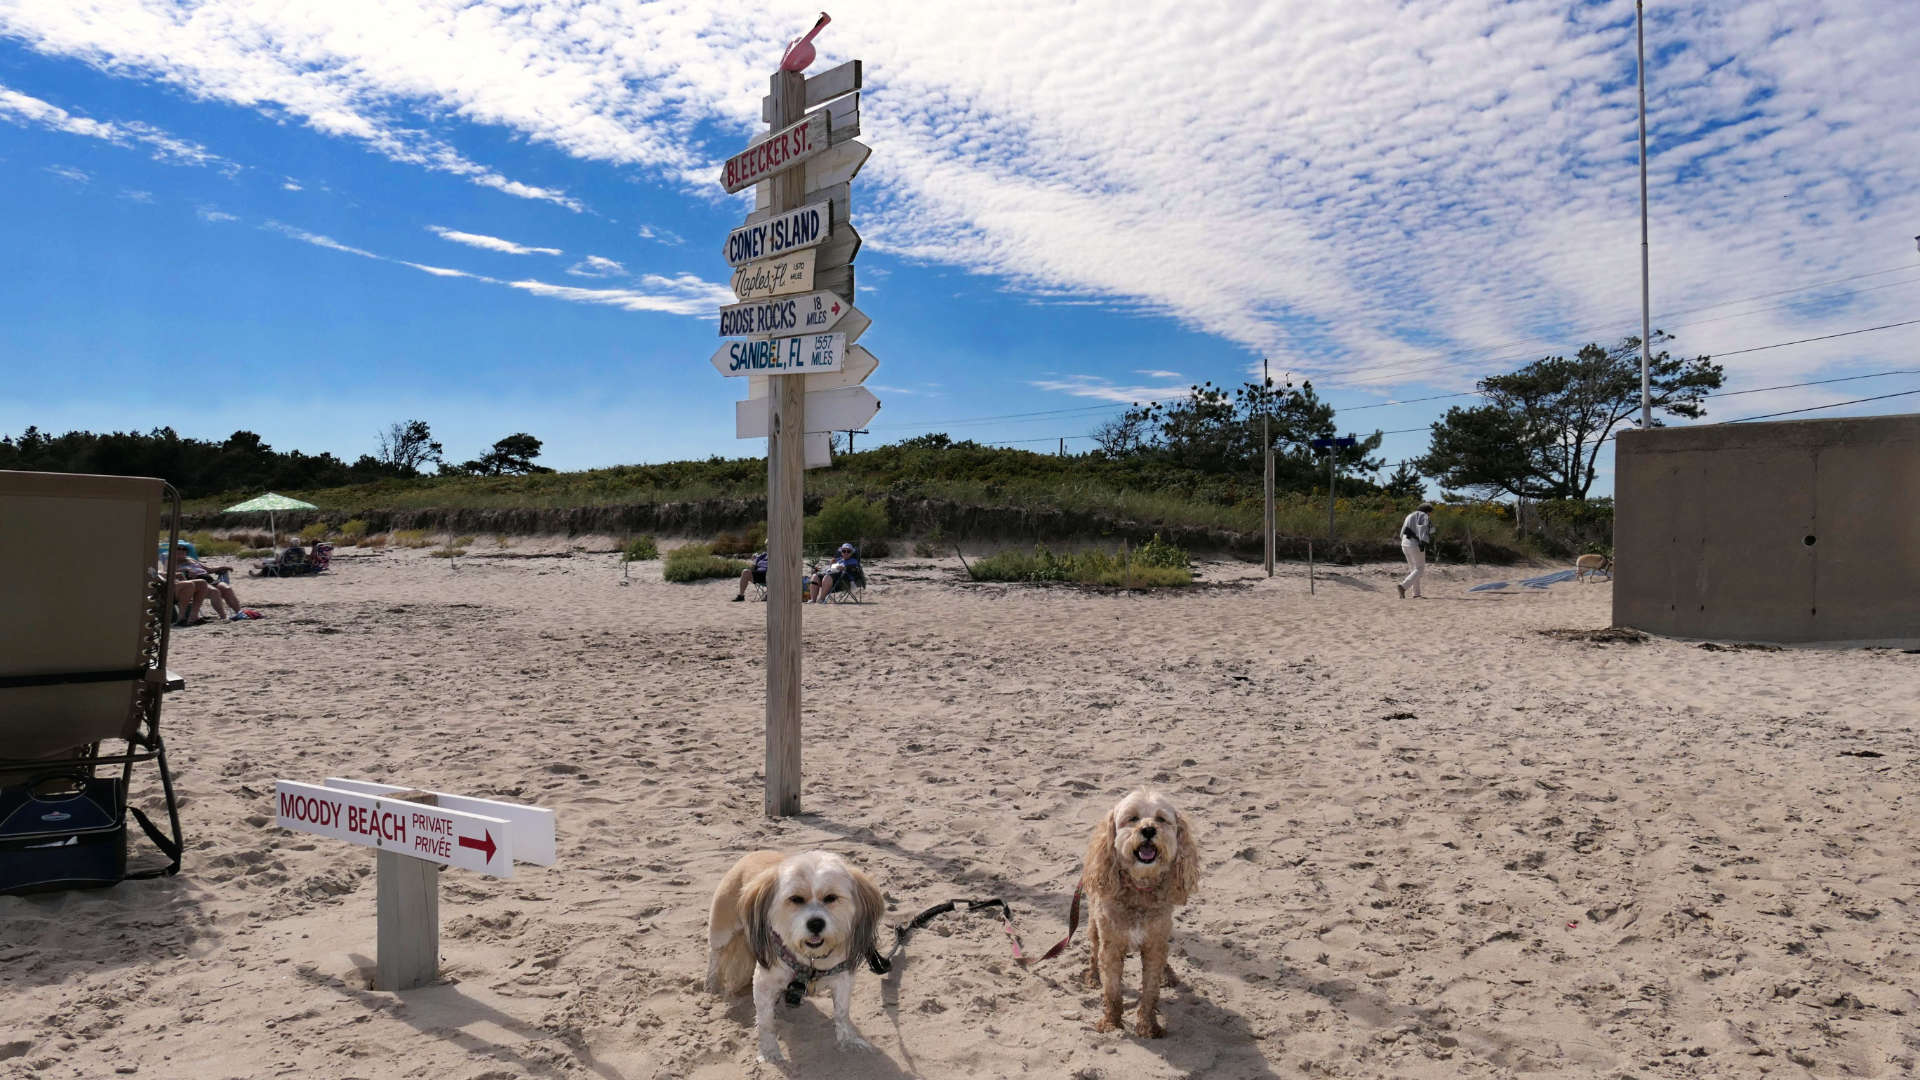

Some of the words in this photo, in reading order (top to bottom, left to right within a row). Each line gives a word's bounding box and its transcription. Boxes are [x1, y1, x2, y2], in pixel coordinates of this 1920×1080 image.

[727, 134, 790, 187] BLEECKER
[793, 123, 812, 156] ST.
[729, 225, 767, 262] CONEY
[770, 209, 820, 251] ISLAND
[735, 265, 770, 297] Naples
[813, 296, 822, 311] 18
[720, 305, 754, 335] GOOSE
[757, 300, 796, 332] ROCKS
[806, 310, 827, 326] MILES
[729, 338, 787, 371] SANIBEL,
[789, 338, 804, 367] FL
[815, 335, 833, 350] 1557
[811, 350, 833, 366] MILES
[280, 792, 342, 828] MOODY
[348, 805, 406, 843] BEACH
[412, 813, 453, 836] PRIVATE
[414, 835, 452, 858] PRIVÉE
